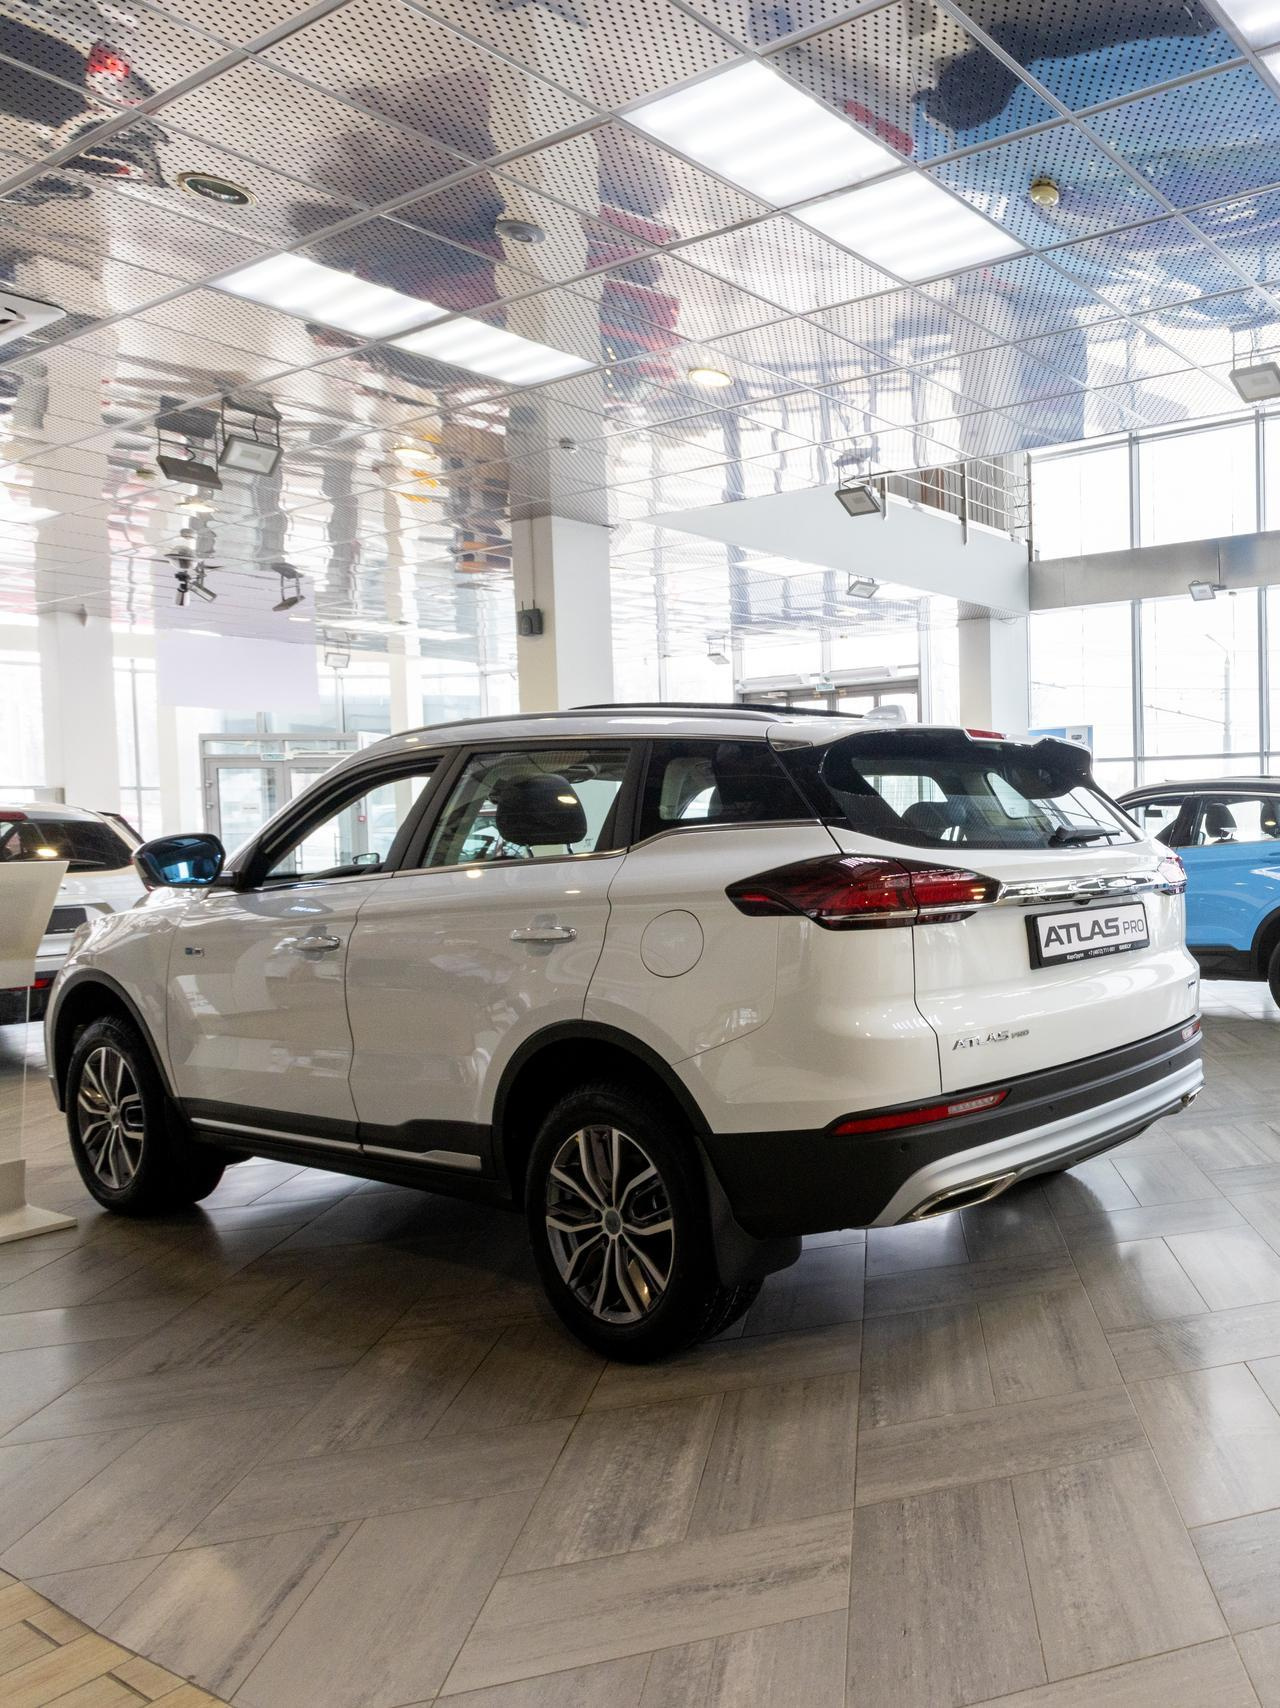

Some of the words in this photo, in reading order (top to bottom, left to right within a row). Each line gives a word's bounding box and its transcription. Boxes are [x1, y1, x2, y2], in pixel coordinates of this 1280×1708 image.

[1043, 917, 1120, 949] ATLAS
[1123, 919, 1145, 935] PRO
[952, 1030, 1009, 1051] ATLAS
[1011, 1029, 1029, 1039] PRO
